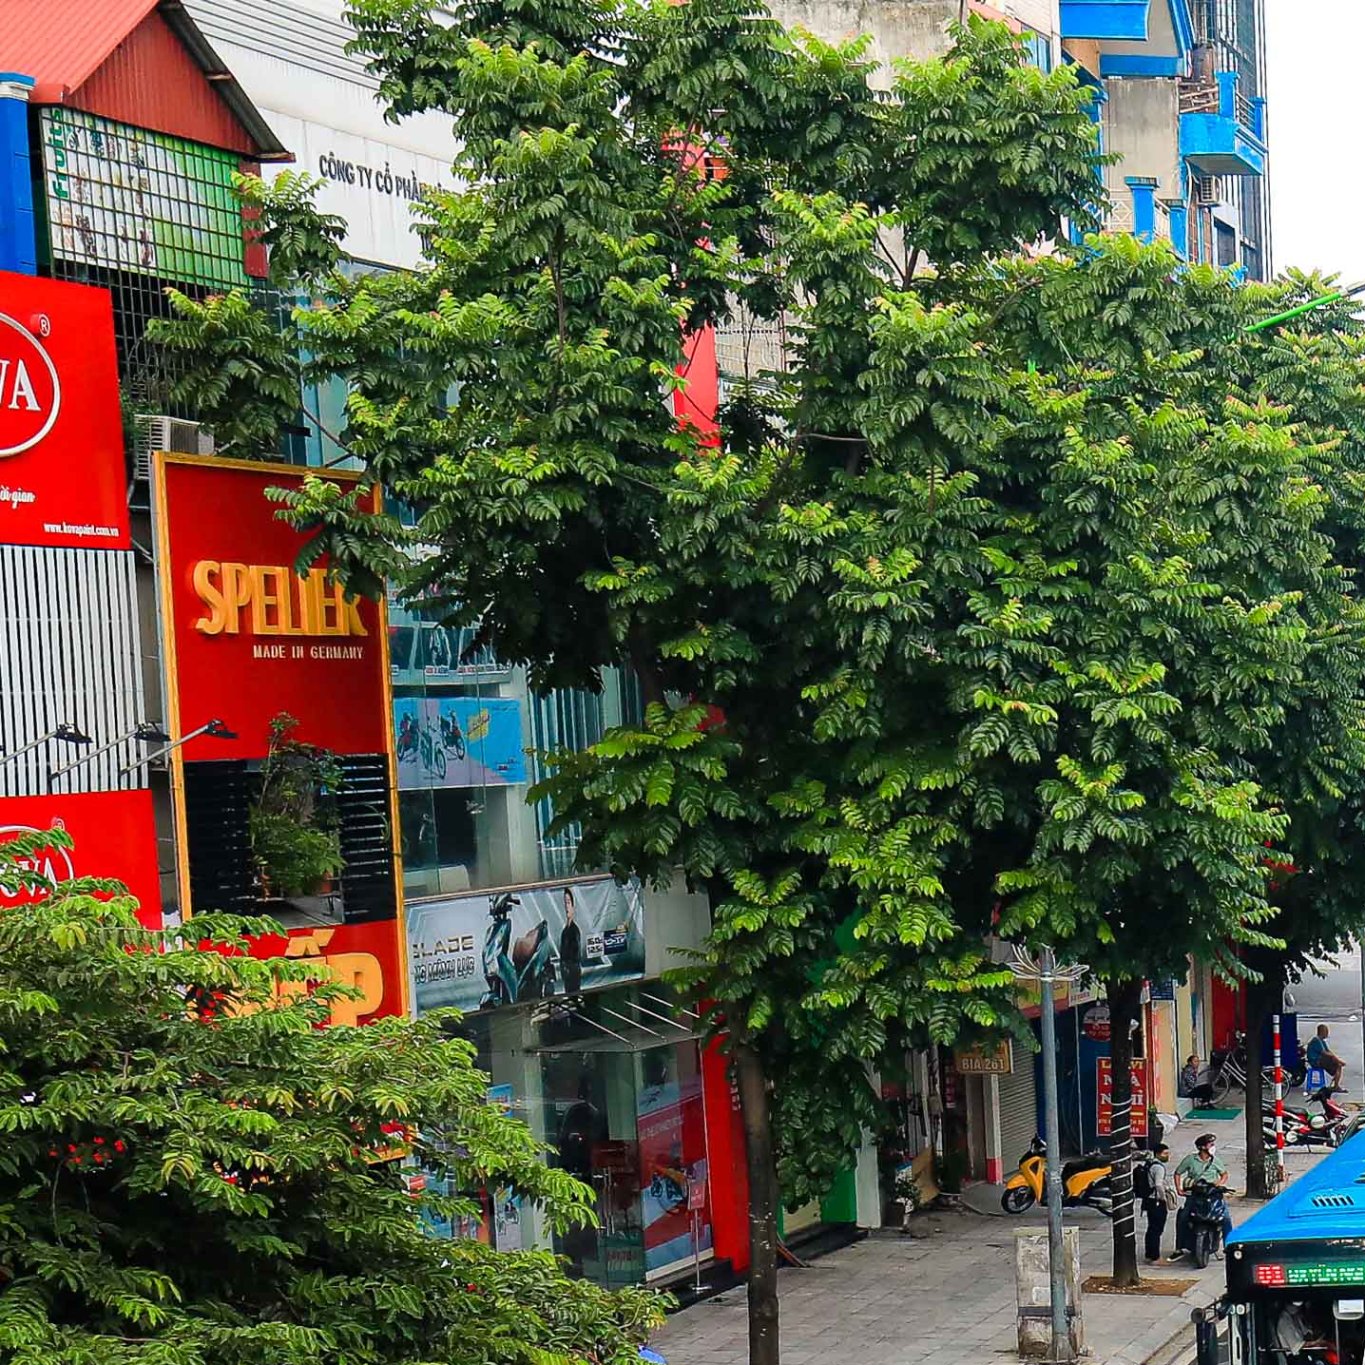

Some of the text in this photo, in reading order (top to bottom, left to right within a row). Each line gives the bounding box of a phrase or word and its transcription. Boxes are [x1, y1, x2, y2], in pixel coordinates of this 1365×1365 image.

[319, 152, 356, 185] CÔNG
[357, 166, 373, 190] TY
[376, 161, 394, 195] CỔ
[253, 645, 363, 660] MADE IN GERMANY
